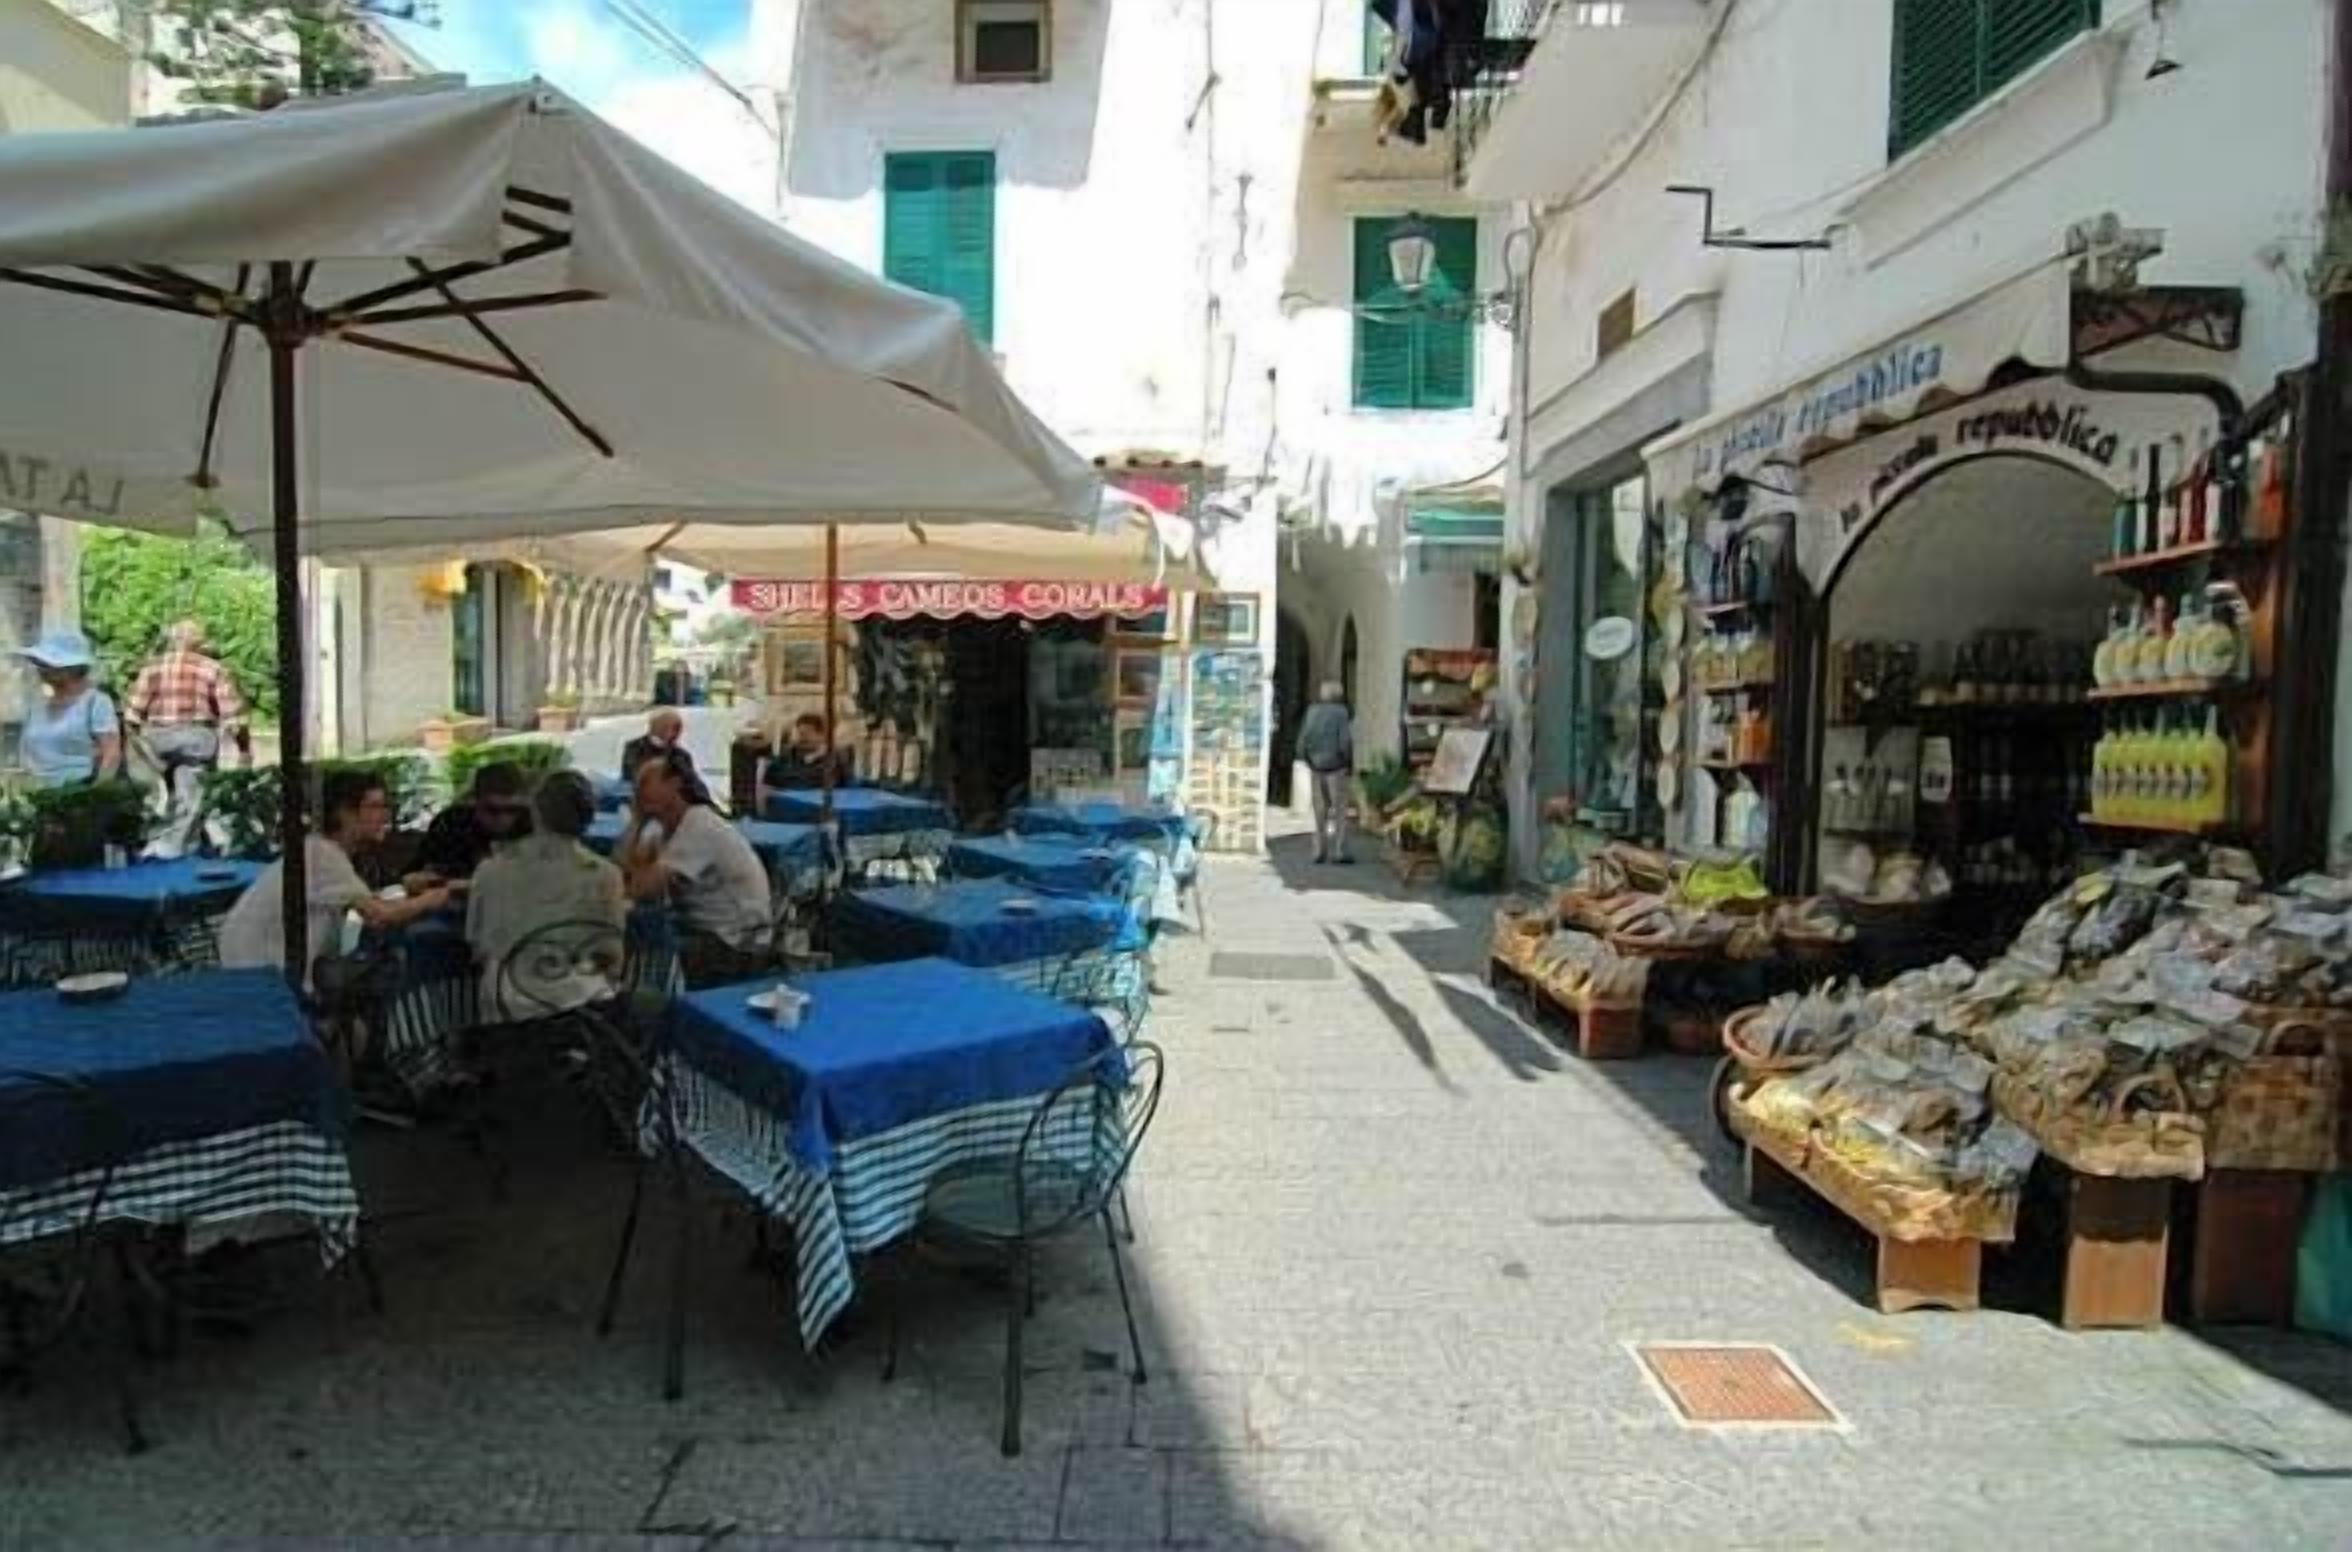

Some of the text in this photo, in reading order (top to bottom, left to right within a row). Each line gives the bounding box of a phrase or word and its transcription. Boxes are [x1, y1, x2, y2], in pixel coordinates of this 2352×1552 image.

[1957, 401, 2119, 466] repubblica
[880, 582, 1005, 610] CAMEOS
[1022, 582, 1145, 610] CORALS
